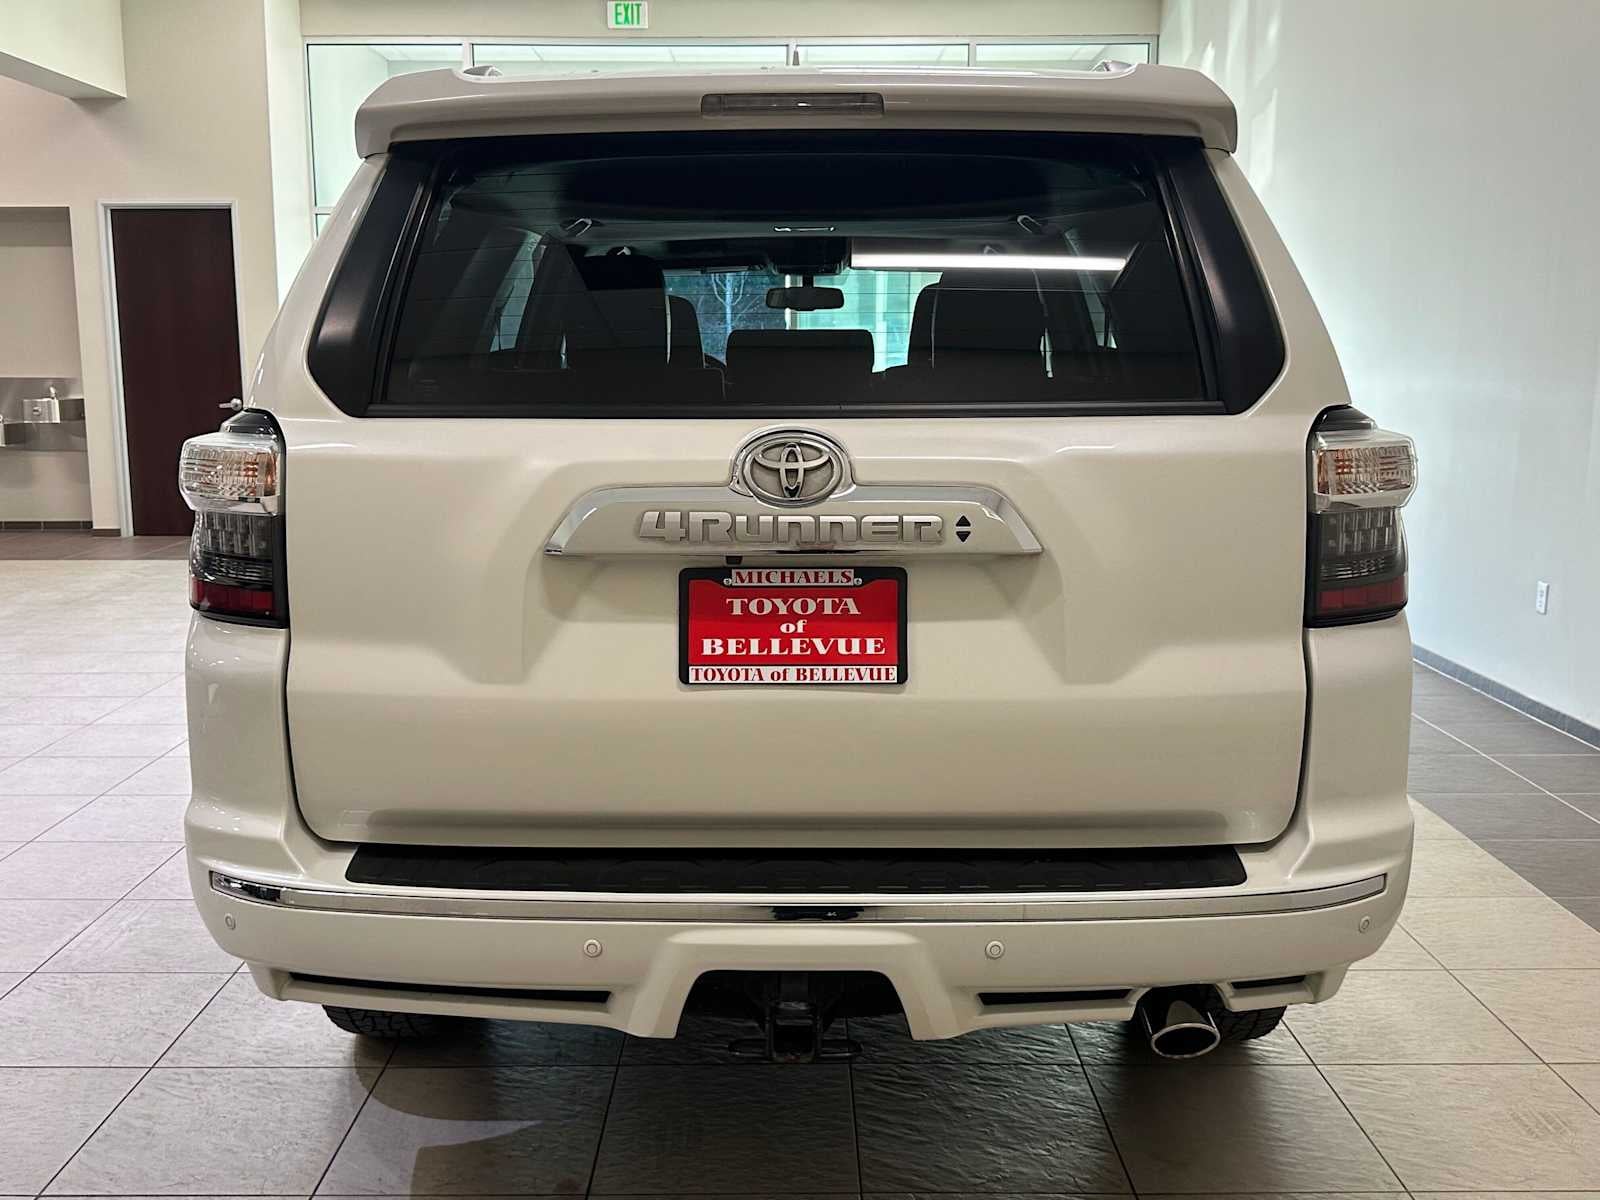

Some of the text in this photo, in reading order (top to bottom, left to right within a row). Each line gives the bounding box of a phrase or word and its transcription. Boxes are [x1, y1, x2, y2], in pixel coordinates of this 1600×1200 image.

[615, 3, 642, 25] EXIT
[735, 571, 852, 584] MICHAELS
[726, 598, 860, 615] TOYOTA
[780, 620, 807, 633] of
[701, 638, 885, 655] BELLEVUE
[691, 668, 896, 681] TOYOTA of BELLEVUE
